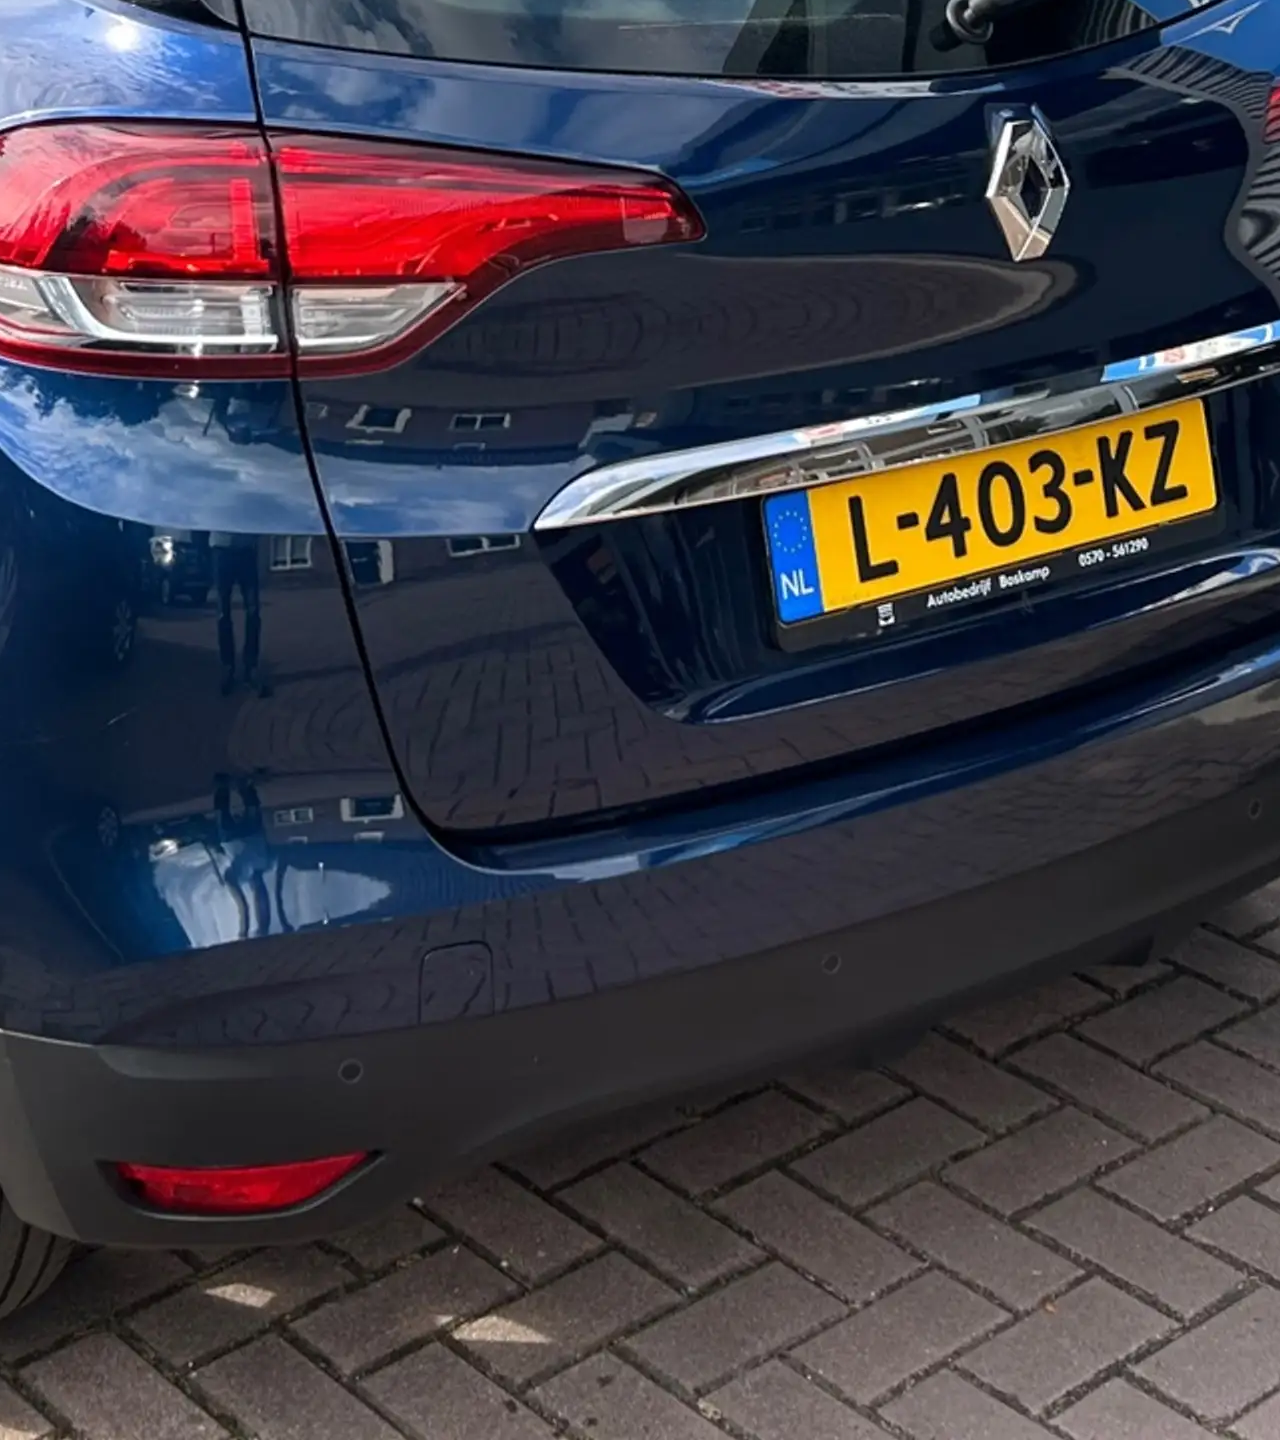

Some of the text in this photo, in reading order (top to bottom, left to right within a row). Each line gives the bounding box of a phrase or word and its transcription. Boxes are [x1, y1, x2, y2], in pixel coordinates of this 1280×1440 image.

[848, 419, 1188, 584] L-403-KZ
[780, 570, 815, 601] NL
[926, 579, 992, 609] Autobedrijf
